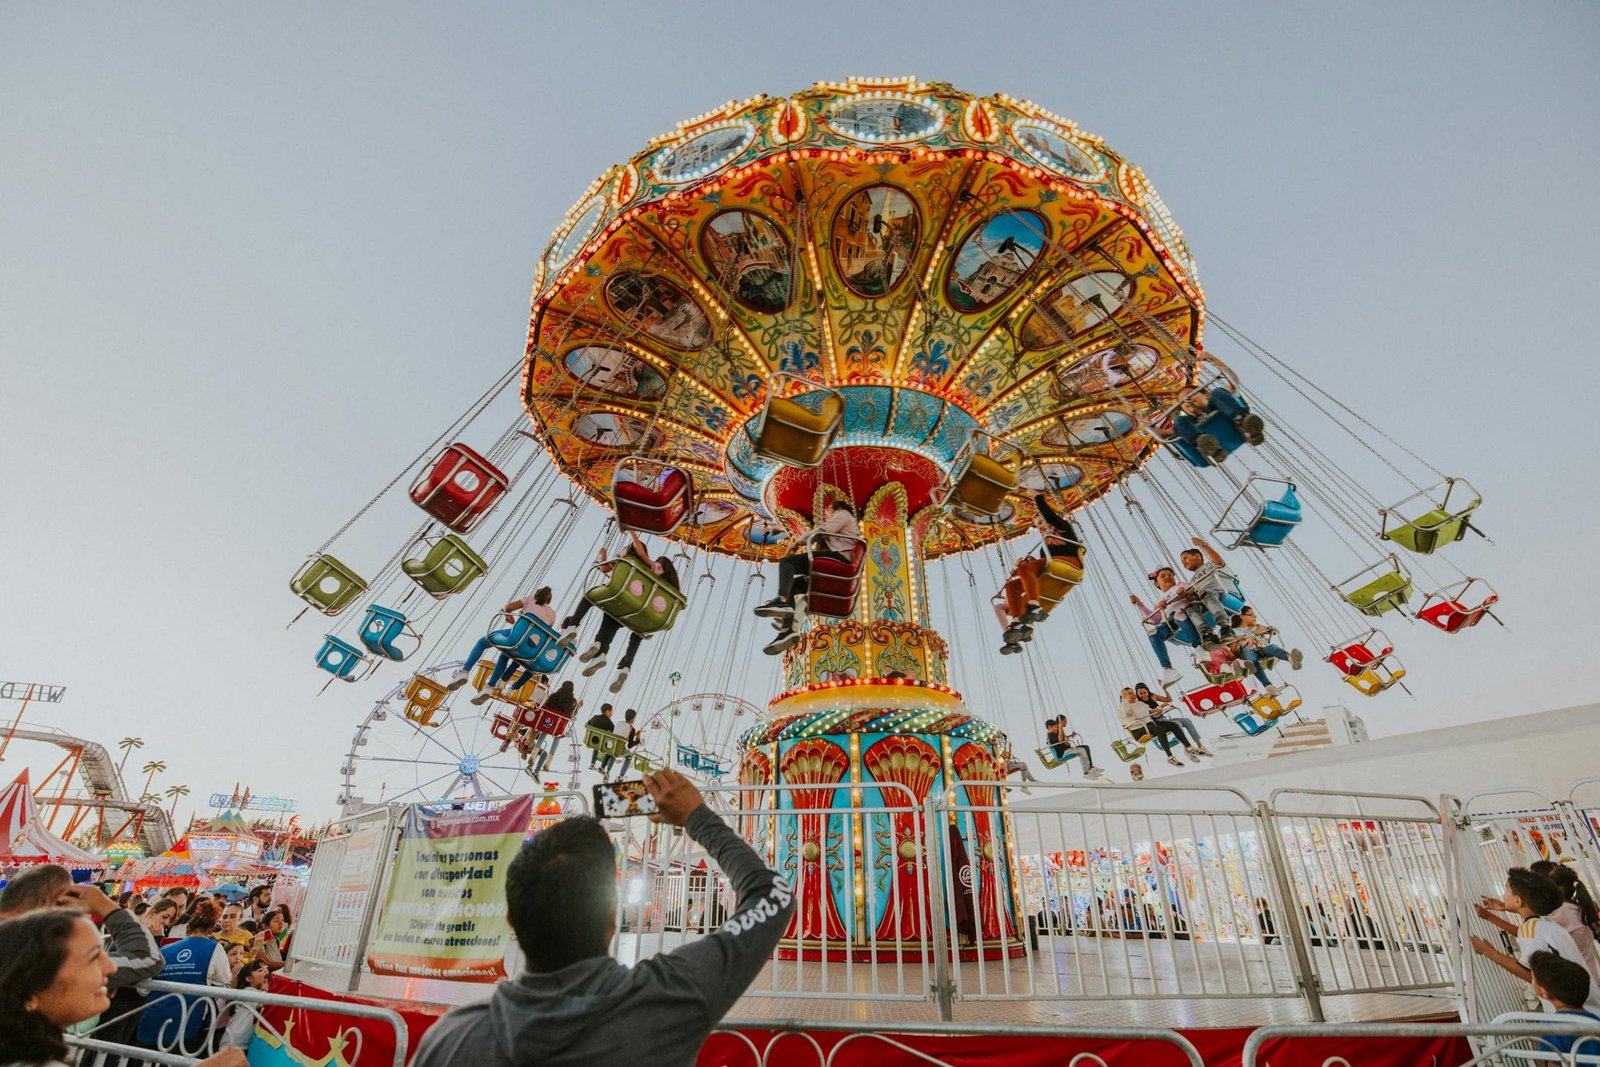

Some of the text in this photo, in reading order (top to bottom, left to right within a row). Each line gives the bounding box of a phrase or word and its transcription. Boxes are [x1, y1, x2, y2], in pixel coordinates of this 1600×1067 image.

[448, 850, 499, 865] personas
[446, 921, 475, 933] gratis
[415, 936, 443, 946] nestras
[444, 935, 501, 947] atracciones!
